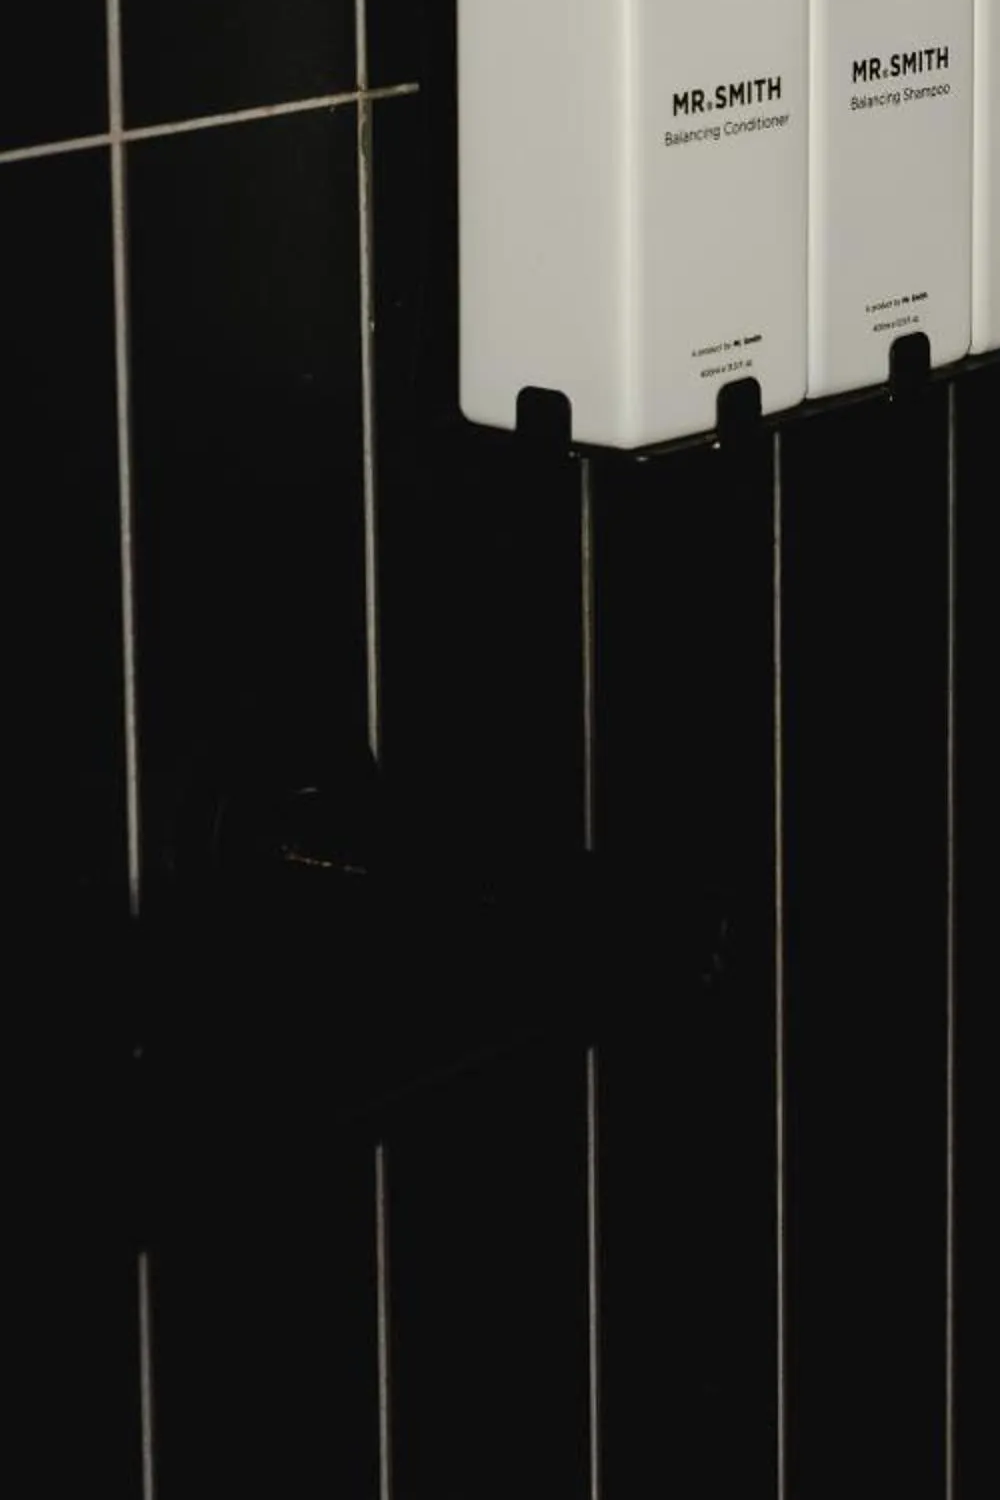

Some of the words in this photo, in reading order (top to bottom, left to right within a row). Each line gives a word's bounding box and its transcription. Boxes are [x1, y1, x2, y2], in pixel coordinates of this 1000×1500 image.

[850, 91, 900, 110] Balancing
[903, 84, 951, 101] Shampoo
[664, 126, 721, 147] Balancing
[723, 114, 790, 136] Conditioner
